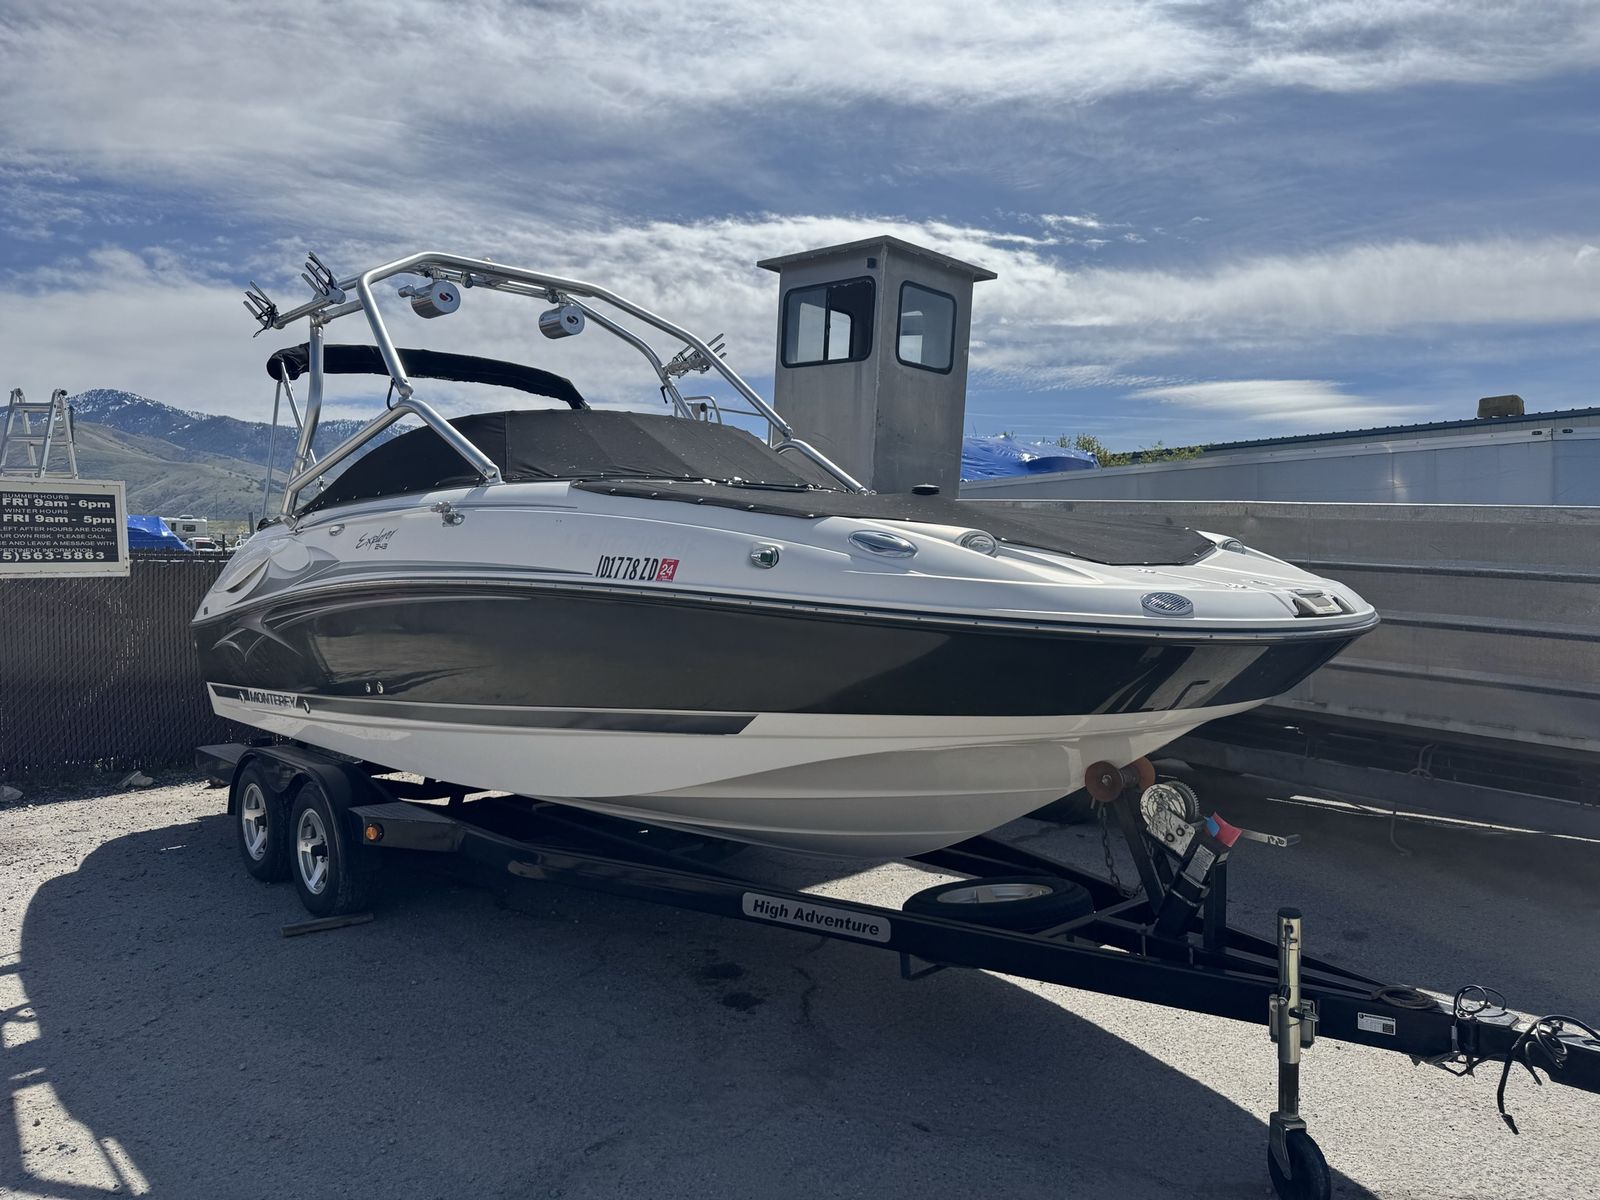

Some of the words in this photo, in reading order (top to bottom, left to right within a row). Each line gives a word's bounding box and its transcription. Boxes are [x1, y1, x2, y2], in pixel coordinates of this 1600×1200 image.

[2, 498, 29, 506] FRI
[34, 499, 68, 507] 9am
[79, 500, 111, 509] 6pm
[3, 514, 30, 522] FRI
[35, 514, 69, 523] 9am
[83, 515, 116, 525] 5pm
[249, 690, 297, 708] MONTEREY
[752, 899, 789, 919] High
[793, 907, 880, 936] Adventure
